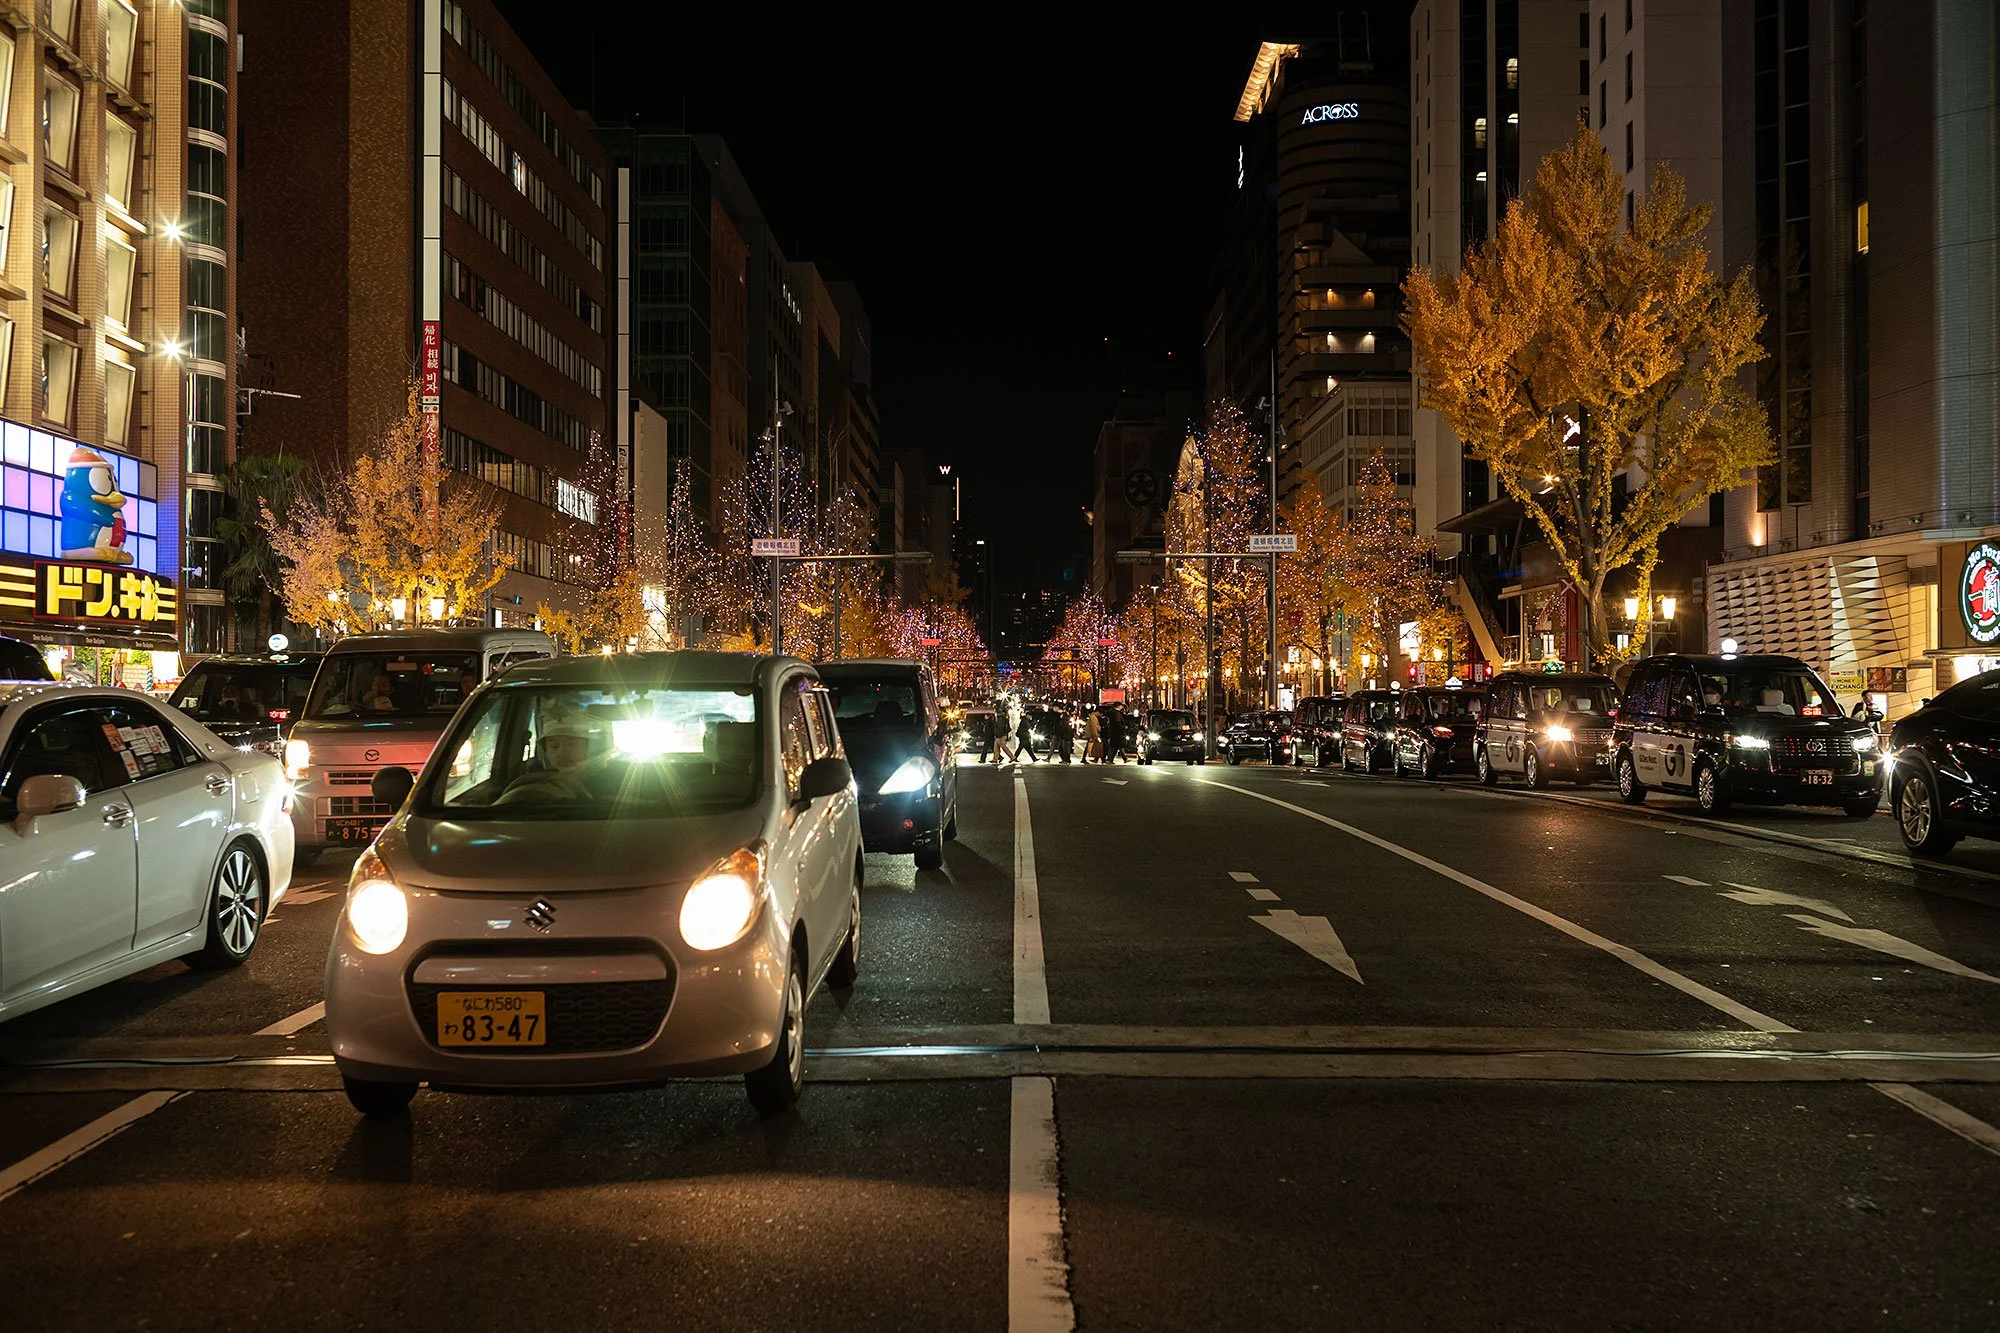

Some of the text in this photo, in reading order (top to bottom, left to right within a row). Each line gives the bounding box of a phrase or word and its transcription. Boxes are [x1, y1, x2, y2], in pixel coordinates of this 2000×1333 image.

[1301, 103, 1359, 125] ACROSS
[424, 325, 439, 369] 帰化 相続
[425, 372, 438, 394] 비자
[939, 465, 951, 475] W
[462, 996, 522, 1011] なにわ580
[443, 1014, 539, 1042] わ 83-47
